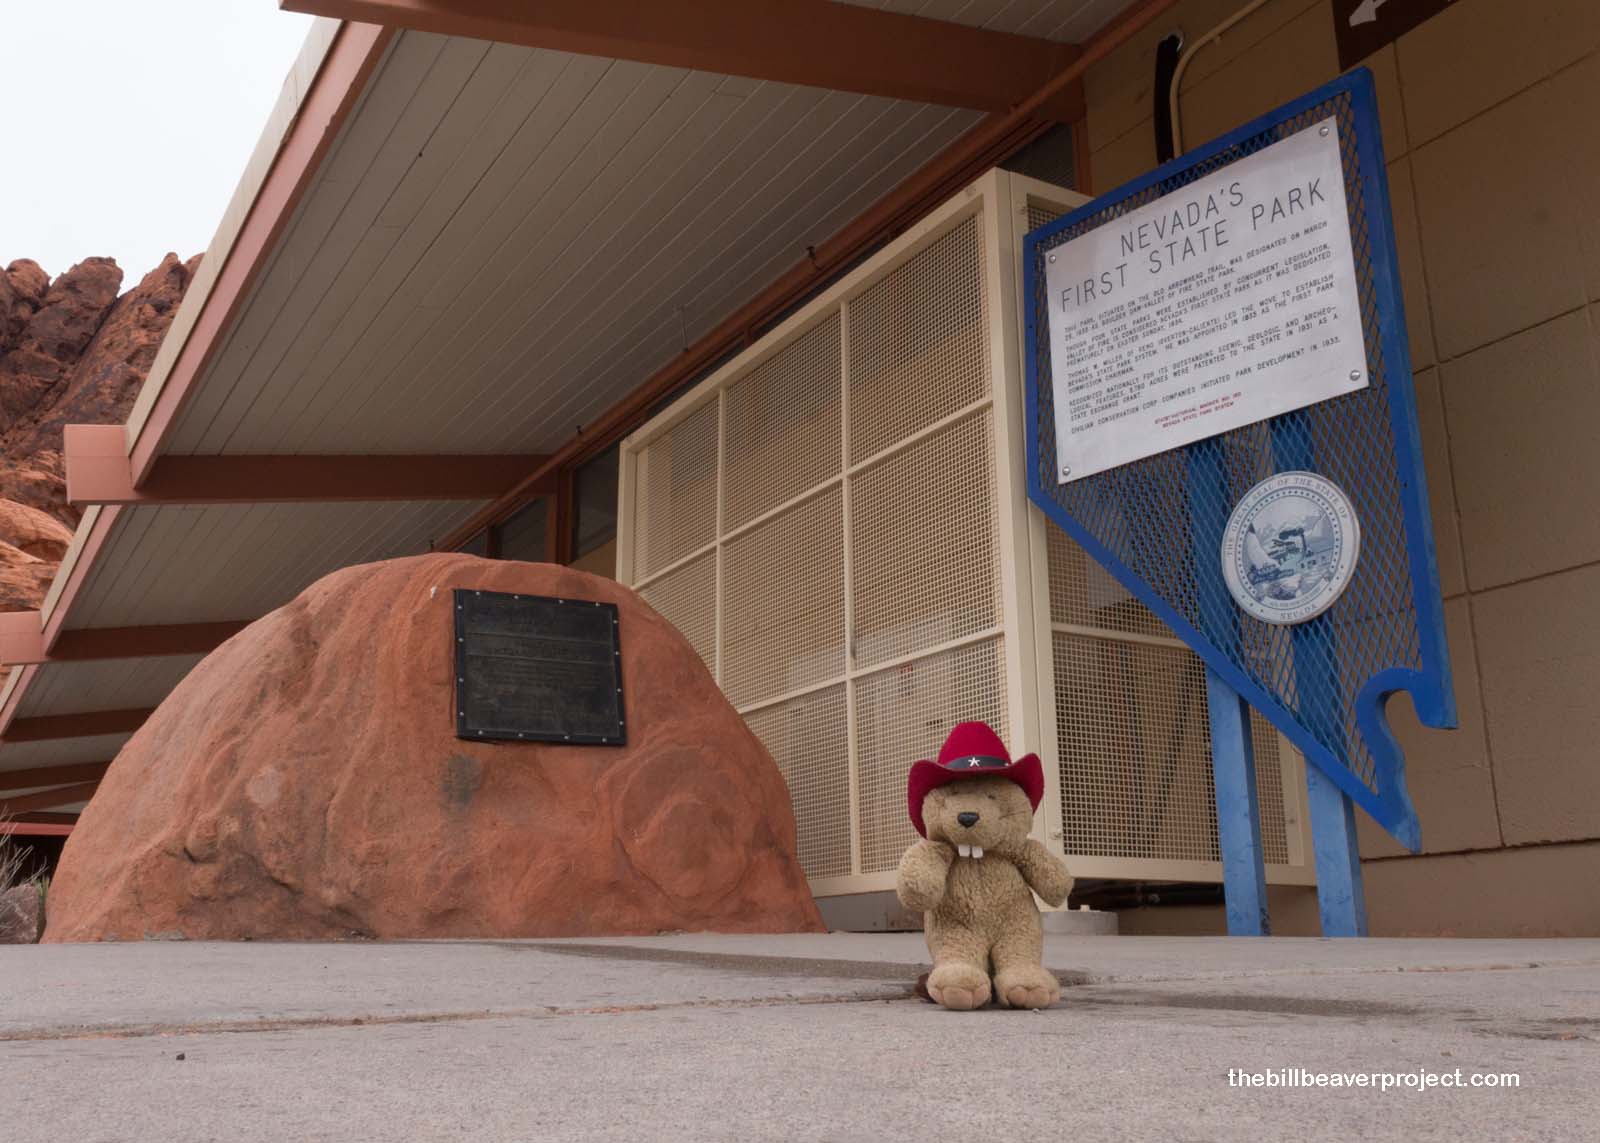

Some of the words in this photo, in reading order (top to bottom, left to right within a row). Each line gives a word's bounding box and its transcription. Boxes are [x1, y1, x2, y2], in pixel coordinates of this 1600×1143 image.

[1060, 262, 1129, 314] FIRST
[1147, 217, 1229, 276] STATE
[1250, 175, 1326, 232] PARK
[1120, 178, 1244, 258] NEVADA'S
[1066, 347, 1085, 361] VALLEY
[1087, 343, 1095, 352] OF
[1097, 337, 1109, 348] FIRE
[1112, 334, 1118, 342] IS
[1121, 318, 1157, 339] CONSIDERED
[1190, 298, 1208, 312] FIRST
[1211, 289, 1230, 303] STATE
[1234, 281, 1250, 294] PARK
[1253, 276, 1263, 286] AS
[1265, 272, 1272, 282] IT
[1275, 266, 1289, 278] WAS
[1292, 249, 1331, 271] DEDICATED
[1091, 321, 1098, 331] AS
[1101, 309, 1126, 326] BOULDER
[1166, 289, 1175, 299] OF
[1178, 282, 1192, 295] FIRE
[1195, 273, 1214, 288] STATE
[1091, 331, 1105, 343] FOUR
[1109, 322, 1127, 335] STATE
[1131, 312, 1150, 327] PARKS
[1155, 304, 1171, 317] WERE
[1176, 285, 1218, 309] ESTABLISHED
[1223, 280, 1232, 290] BY
[1236, 261, 1279, 285] CONCURRENT
[1098, 303, 1124, 320] SITUATED
[1127, 298, 1135, 308] ON
[1138, 292, 1149, 303] THE
[1152, 286, 1164, 297] OLD
[1167, 270, 1203, 291] ARROWHEAD
[1228, 254, 1243, 266] WAS
[1246, 235, 1286, 259] DESIGNATED
[1290, 230, 1300, 240] ON
[1303, 218, 1327, 235] MARCH
[1067, 366, 1088, 380] THOMAS
[1102, 352, 1122, 367] MILLER
[1126, 348, 1134, 358] OF
[1137, 340, 1154, 353] RENO
[1223, 308, 1237, 320] LED
[1240, 302, 1253, 314] THE
[1258, 293, 1276, 307] MOVE
[1281, 287, 1291, 298] TO
[1294, 271, 1334, 293] ESTABLISH
[1095, 364, 1113, 377] STATE
[1115, 357, 1131, 369] PARK
[1164, 341, 1173, 351] HE
[1176, 334, 1190, 346] WAS
[1193, 320, 1227, 340] APPOINTED
[1230, 316, 1238, 326] IN
[1260, 304, 1270, 314] AS
[1273, 297, 1287, 309] THE
[1290, 288, 1312, 303] FIRST
[1315, 279, 1334, 294] PARK
[1106, 343, 1114, 352] ON
[1116, 333, 1139, 348] EASTER
[1106, 375, 1139, 394] NATIONALLY
[1142, 369, 1154, 381] FOR
[1158, 364, 1168, 375] ITS
[1171, 347, 1213, 370] OUTSTANDING
[1284, 316, 1299, 328] AND
[1148, 373, 1168, 387] ACRES
[1172, 365, 1189, 378] WERE
[1193, 352, 1225, 371] PATENTED
[1229, 347, 1238, 358] TO
[1241, 341, 1255, 353] THE
[1259, 332, 1281, 347] STATE
[1285, 327, 1293, 337] IN
[1317, 314, 1328, 326] AS
[1331, 311, 1338, 321] A
[1068, 376, 1102, 395] COMMISSION
[1070, 409, 1087, 422] STATE
[1089, 398, 1118, 415] EXCHANGE
[1161, 384, 1196, 403] COMPANIES
[1199, 372, 1231, 390] INITIATED
[1234, 365, 1251, 377] PARK
[1256, 346, 1305, 370] DEVELOPMENT
[1309, 341, 1318, 352] IN
[1280, 604, 1318, 620] NEVADA
